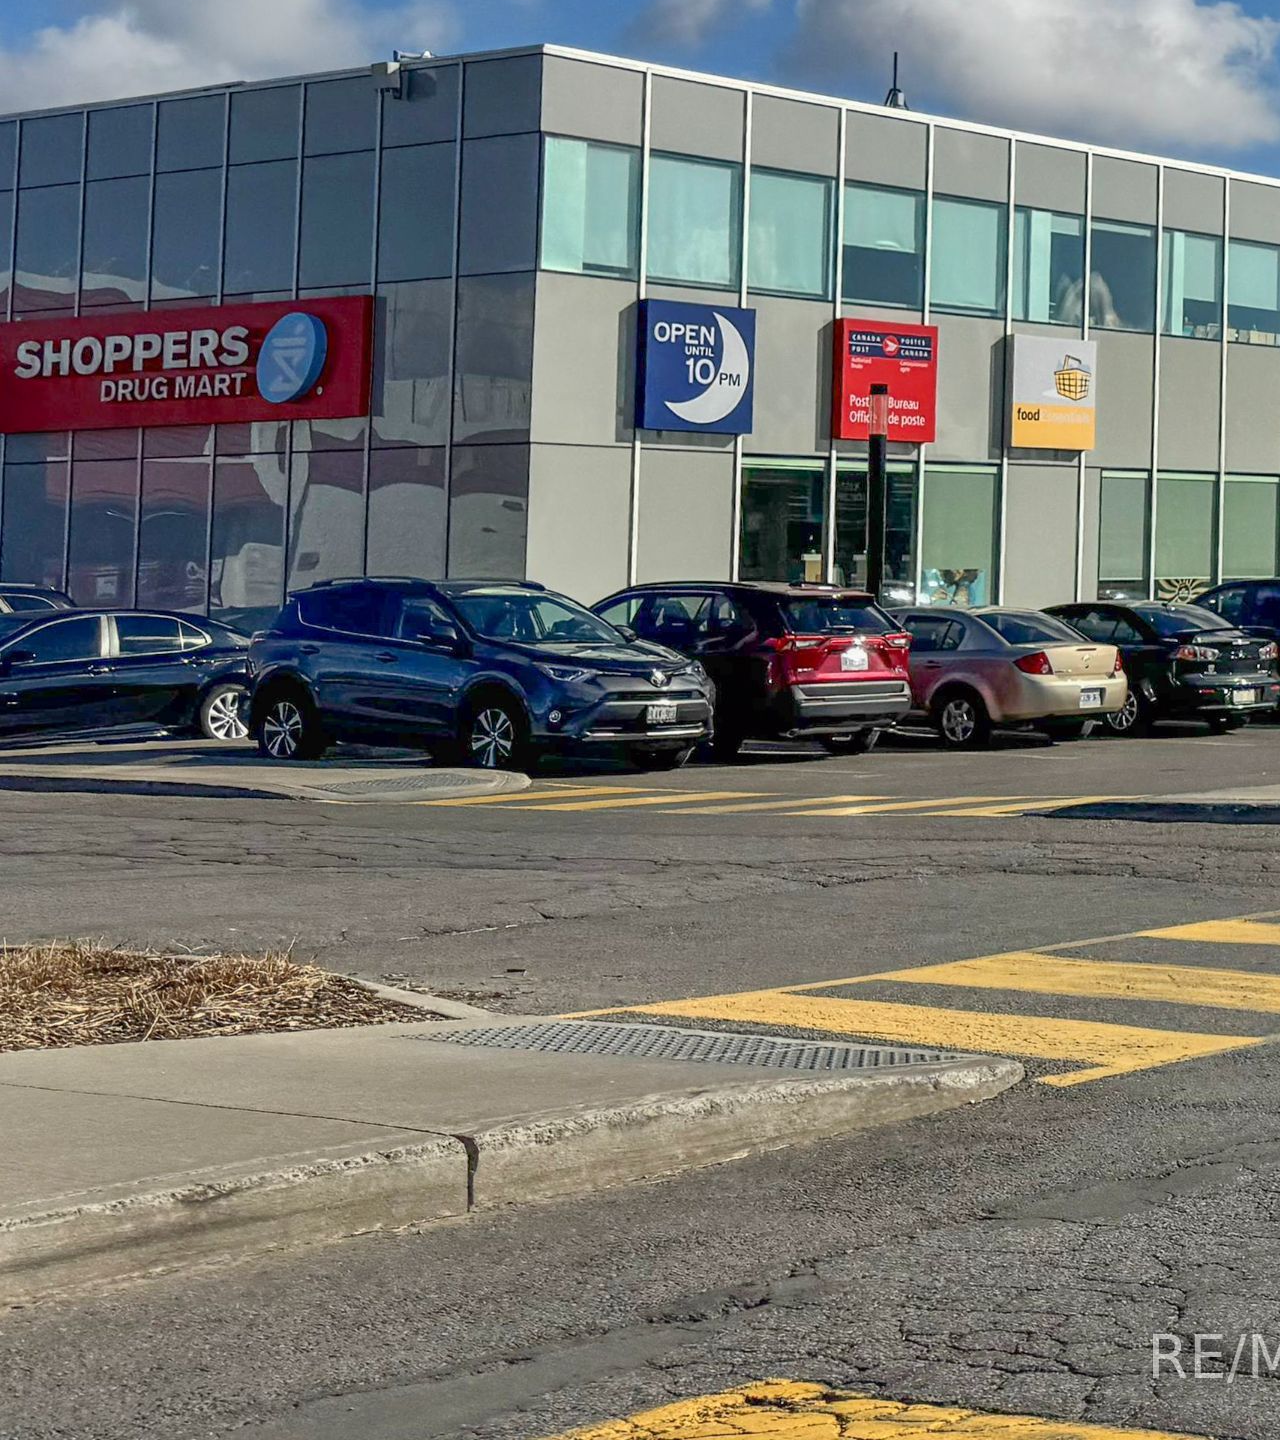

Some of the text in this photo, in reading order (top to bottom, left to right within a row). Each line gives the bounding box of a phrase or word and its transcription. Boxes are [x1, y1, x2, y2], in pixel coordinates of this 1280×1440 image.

[654, 321, 716, 346] OPEN
[851, 333, 881, 343] CANADA
[901, 337, 926, 346] POSTES
[14, 326, 249, 379] SHOPPERS
[684, 346, 714, 357] UNTIL
[851, 345, 870, 353] POST
[900, 349, 929, 357] CANADA
[685, 357, 741, 387] 10 PM
[101, 373, 247, 402] DRUG MART
[849, 394, 870, 408] Post
[888, 397, 919, 410] Bureau
[888, 412, 926, 428] de poste
